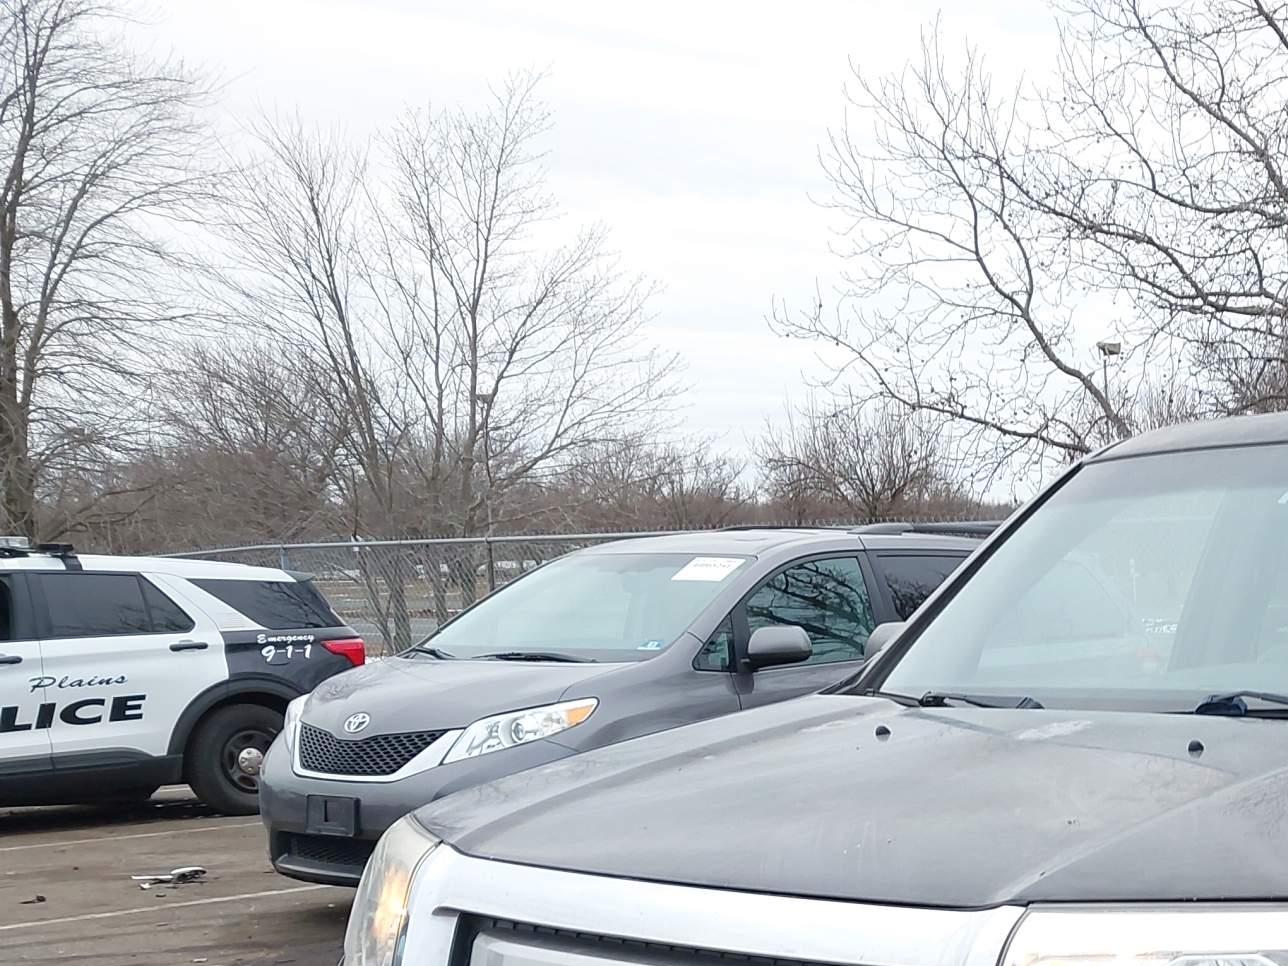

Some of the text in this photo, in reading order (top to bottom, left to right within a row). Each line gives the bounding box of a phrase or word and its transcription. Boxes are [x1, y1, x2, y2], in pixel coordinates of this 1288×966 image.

[256, 633, 315, 644] Emergency
[261, 644, 312, 662] 9-1-1
[29, 675, 128, 693] Plains
